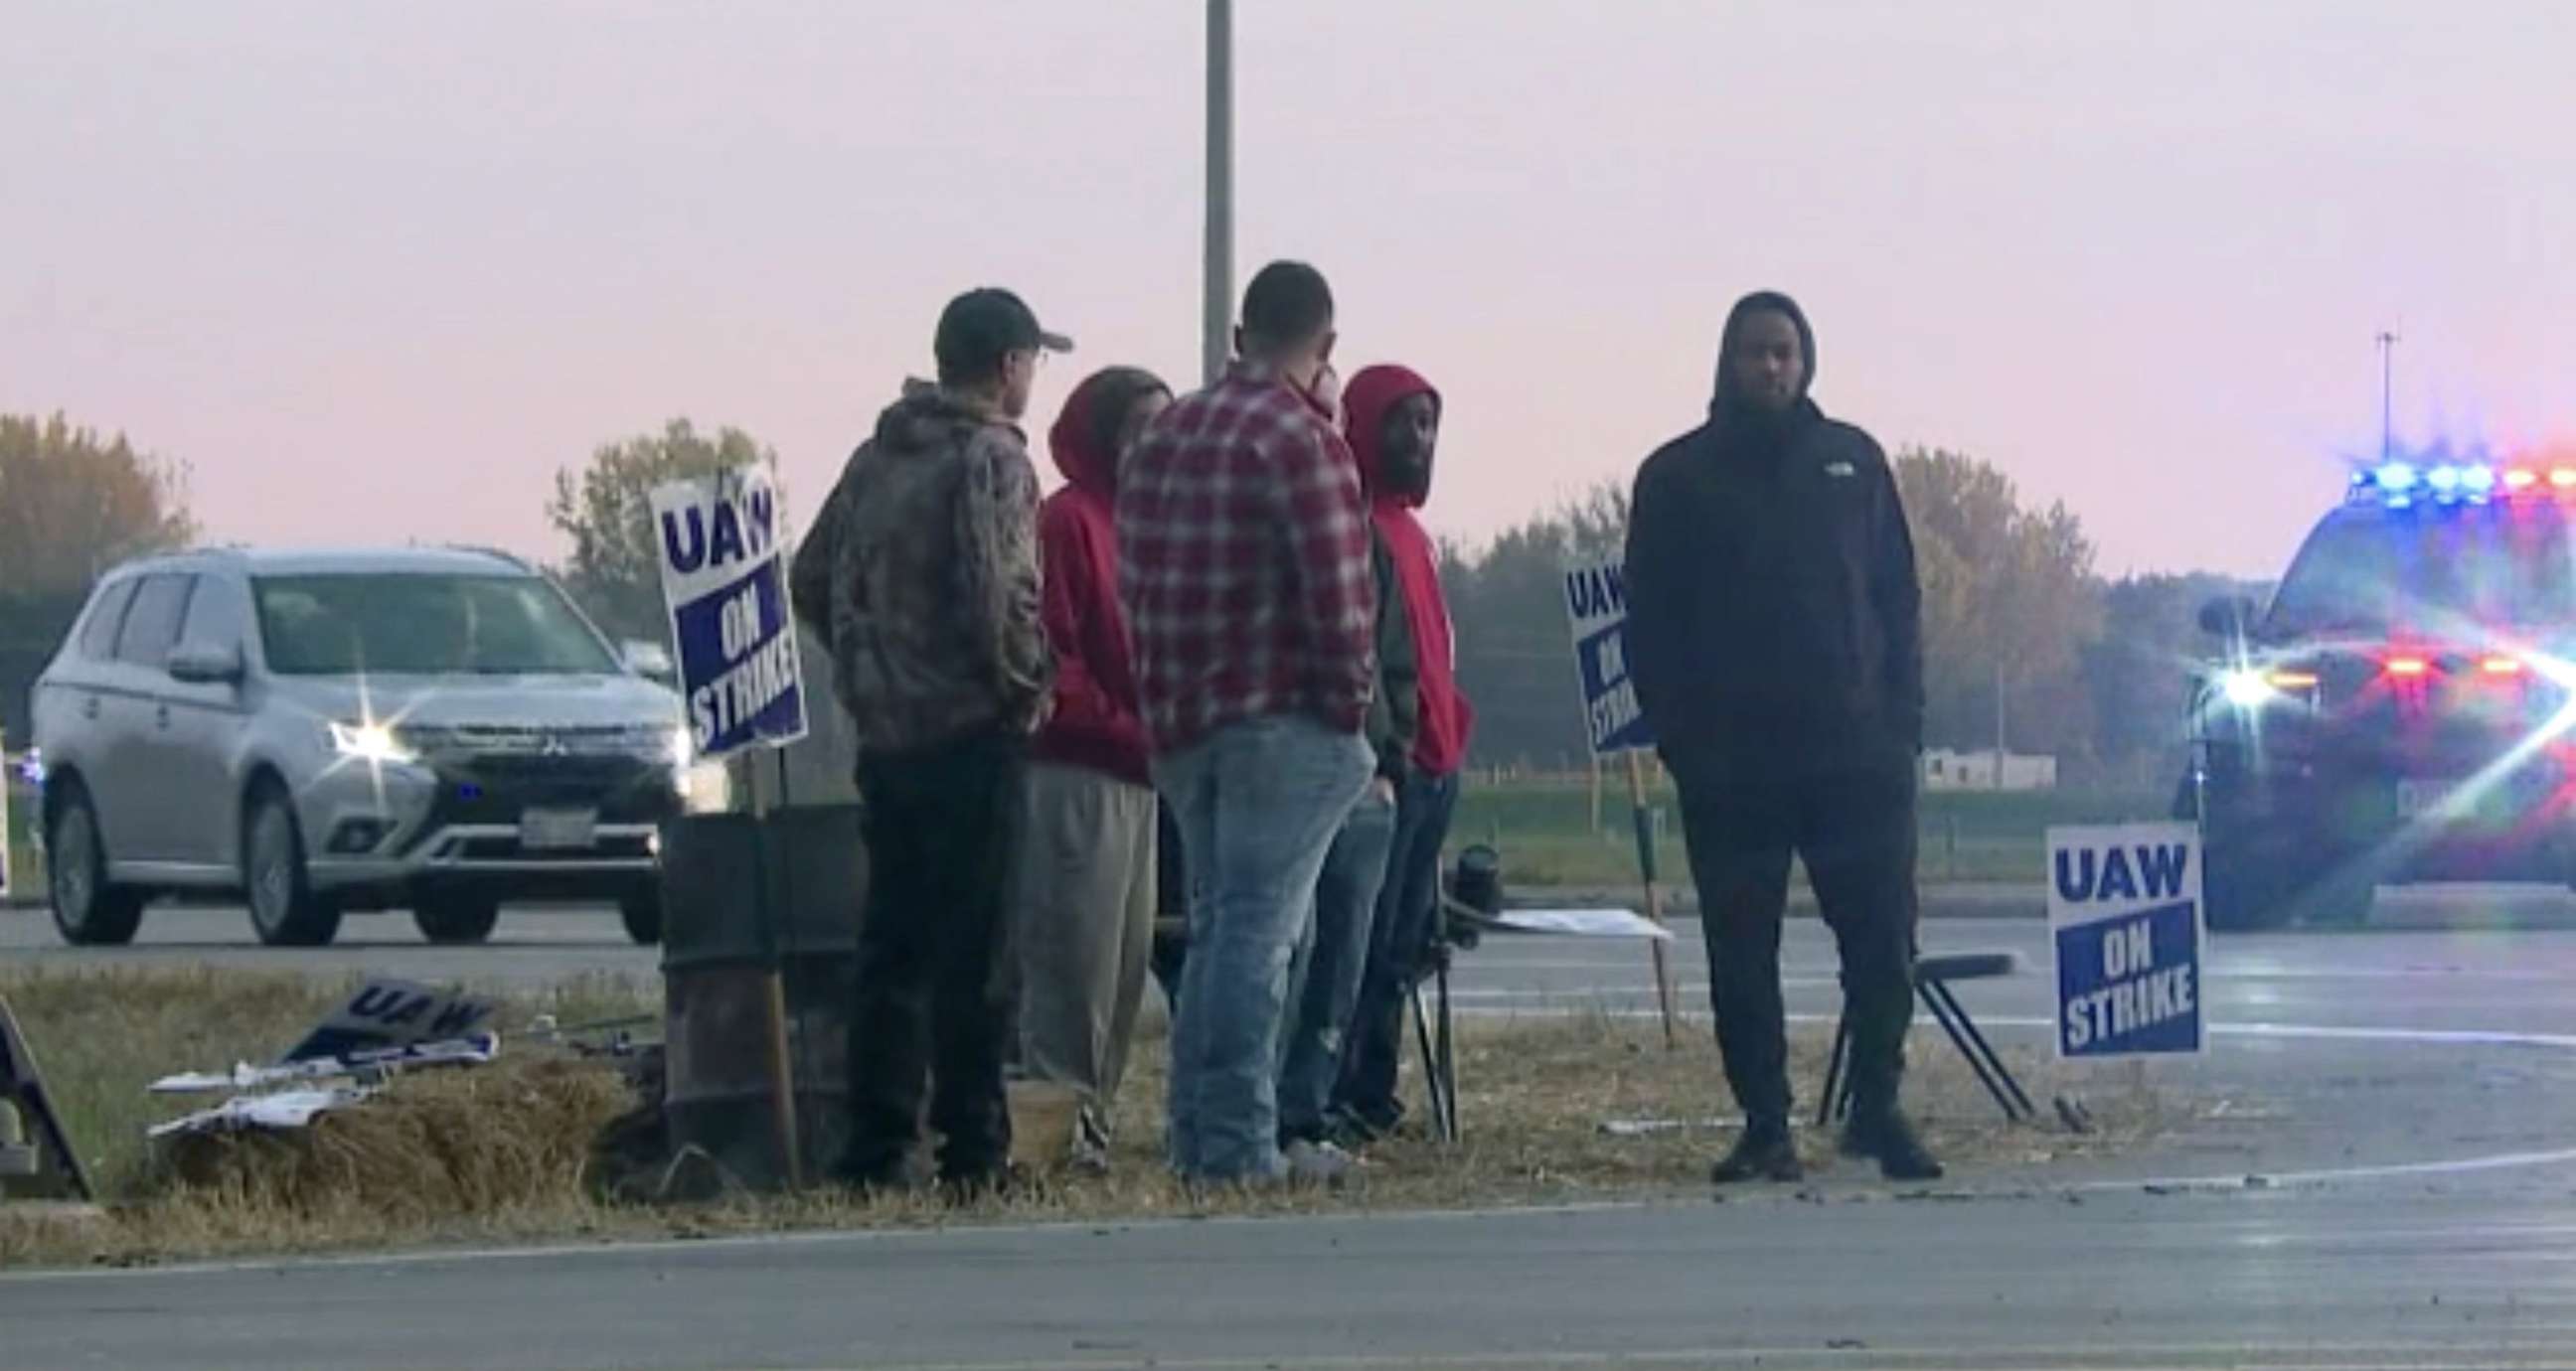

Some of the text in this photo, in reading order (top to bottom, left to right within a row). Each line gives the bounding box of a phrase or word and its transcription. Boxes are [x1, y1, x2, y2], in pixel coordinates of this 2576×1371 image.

[721, 579, 761, 663] ON
[693, 628, 795, 752] STRIKE
[2055, 843, 2186, 902] UAW
[2103, 918, 2153, 980] ON
[350, 986, 495, 1033] UAW
[2066, 963, 2194, 1049] STRIKE
